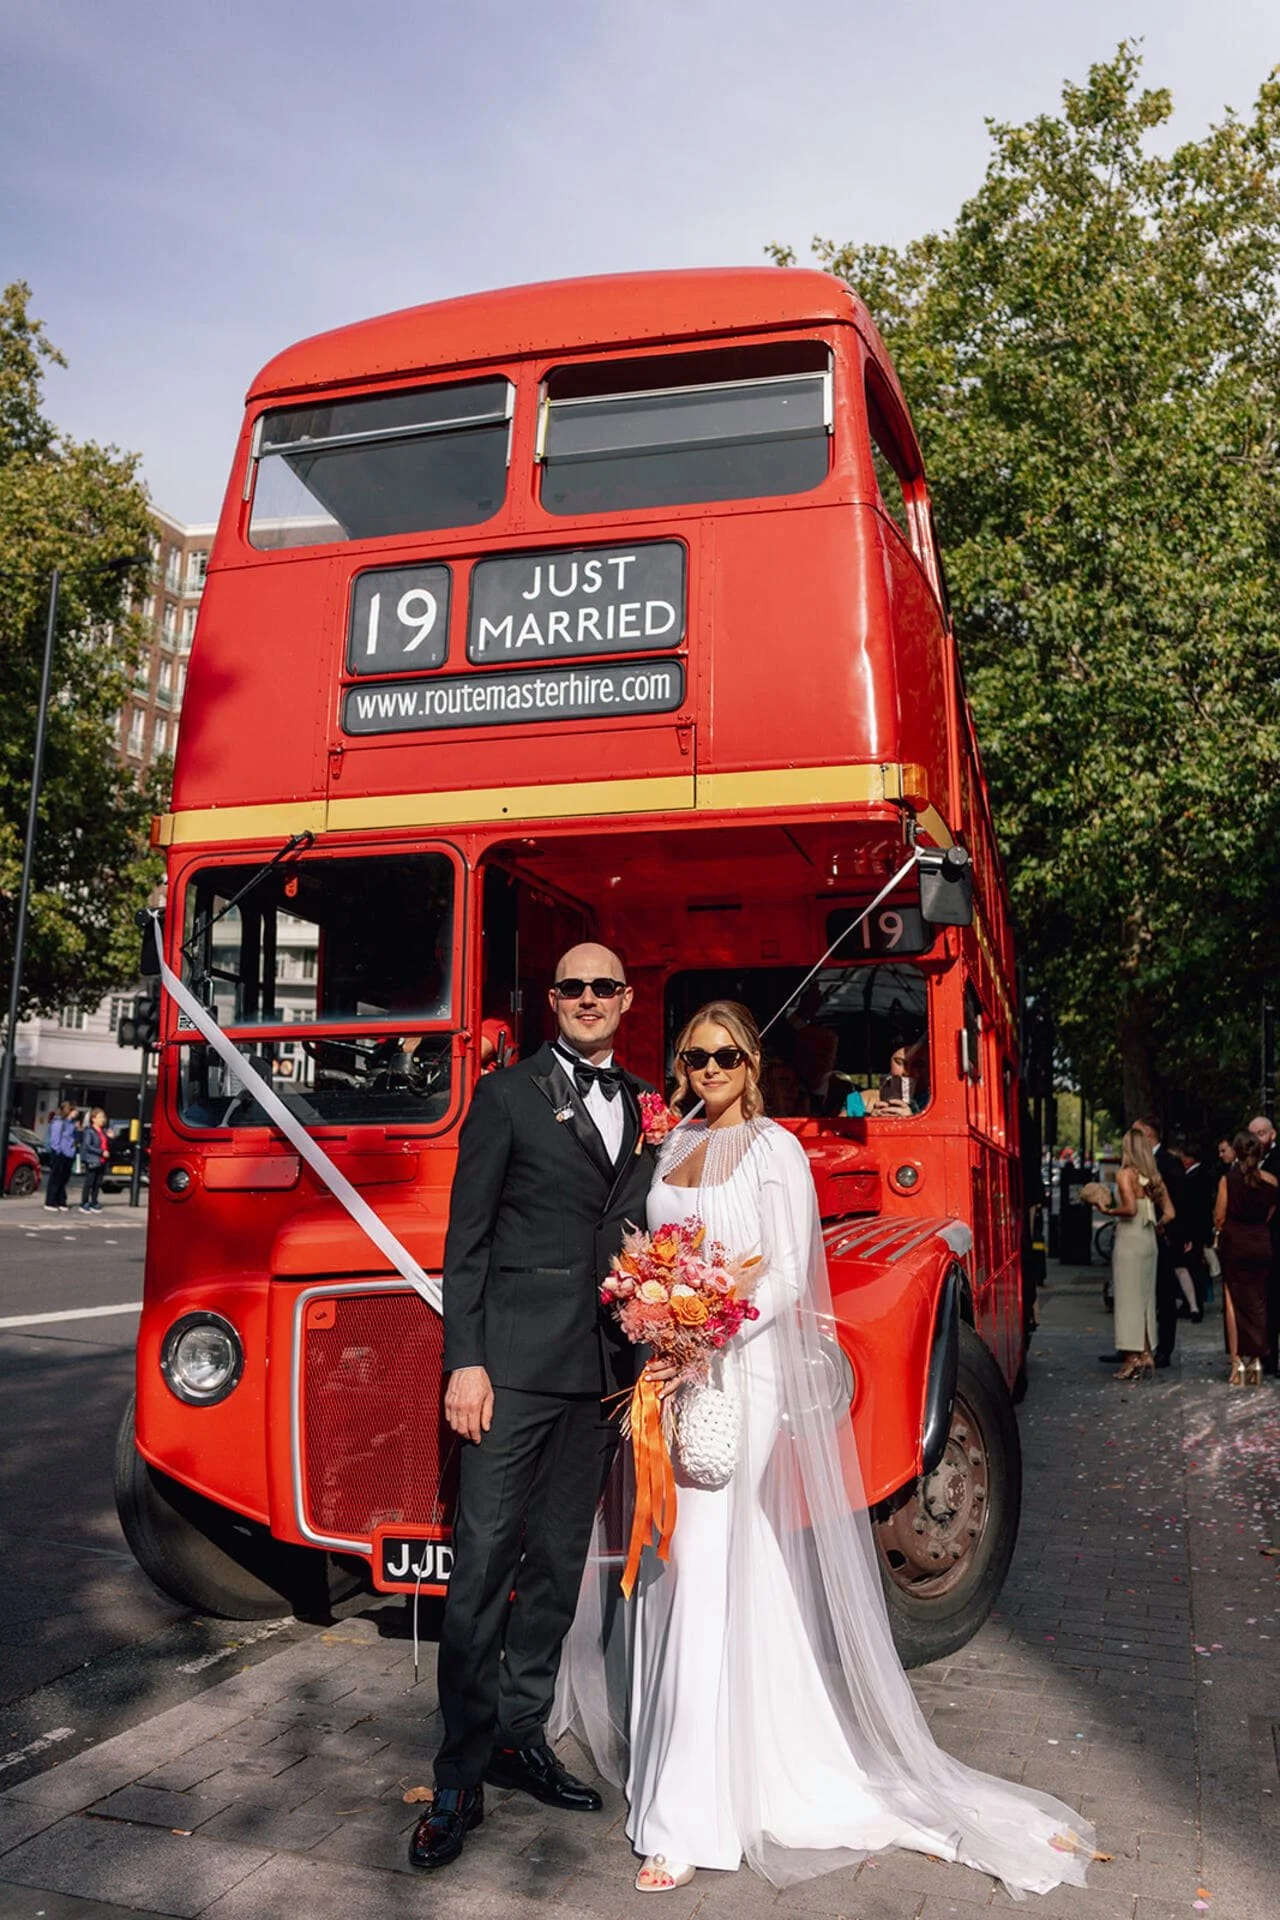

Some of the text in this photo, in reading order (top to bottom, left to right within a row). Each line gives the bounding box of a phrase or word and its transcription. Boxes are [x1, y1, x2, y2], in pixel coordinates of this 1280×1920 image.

[522, 556, 636, 599] JUST
[366, 588, 437, 655] 19
[478, 600, 675, 650] MARRIED
[356, 673, 670, 719] www.routemasterhire.com
[862, 911, 904, 949] 19
[387, 1543, 454, 1580] JJD
